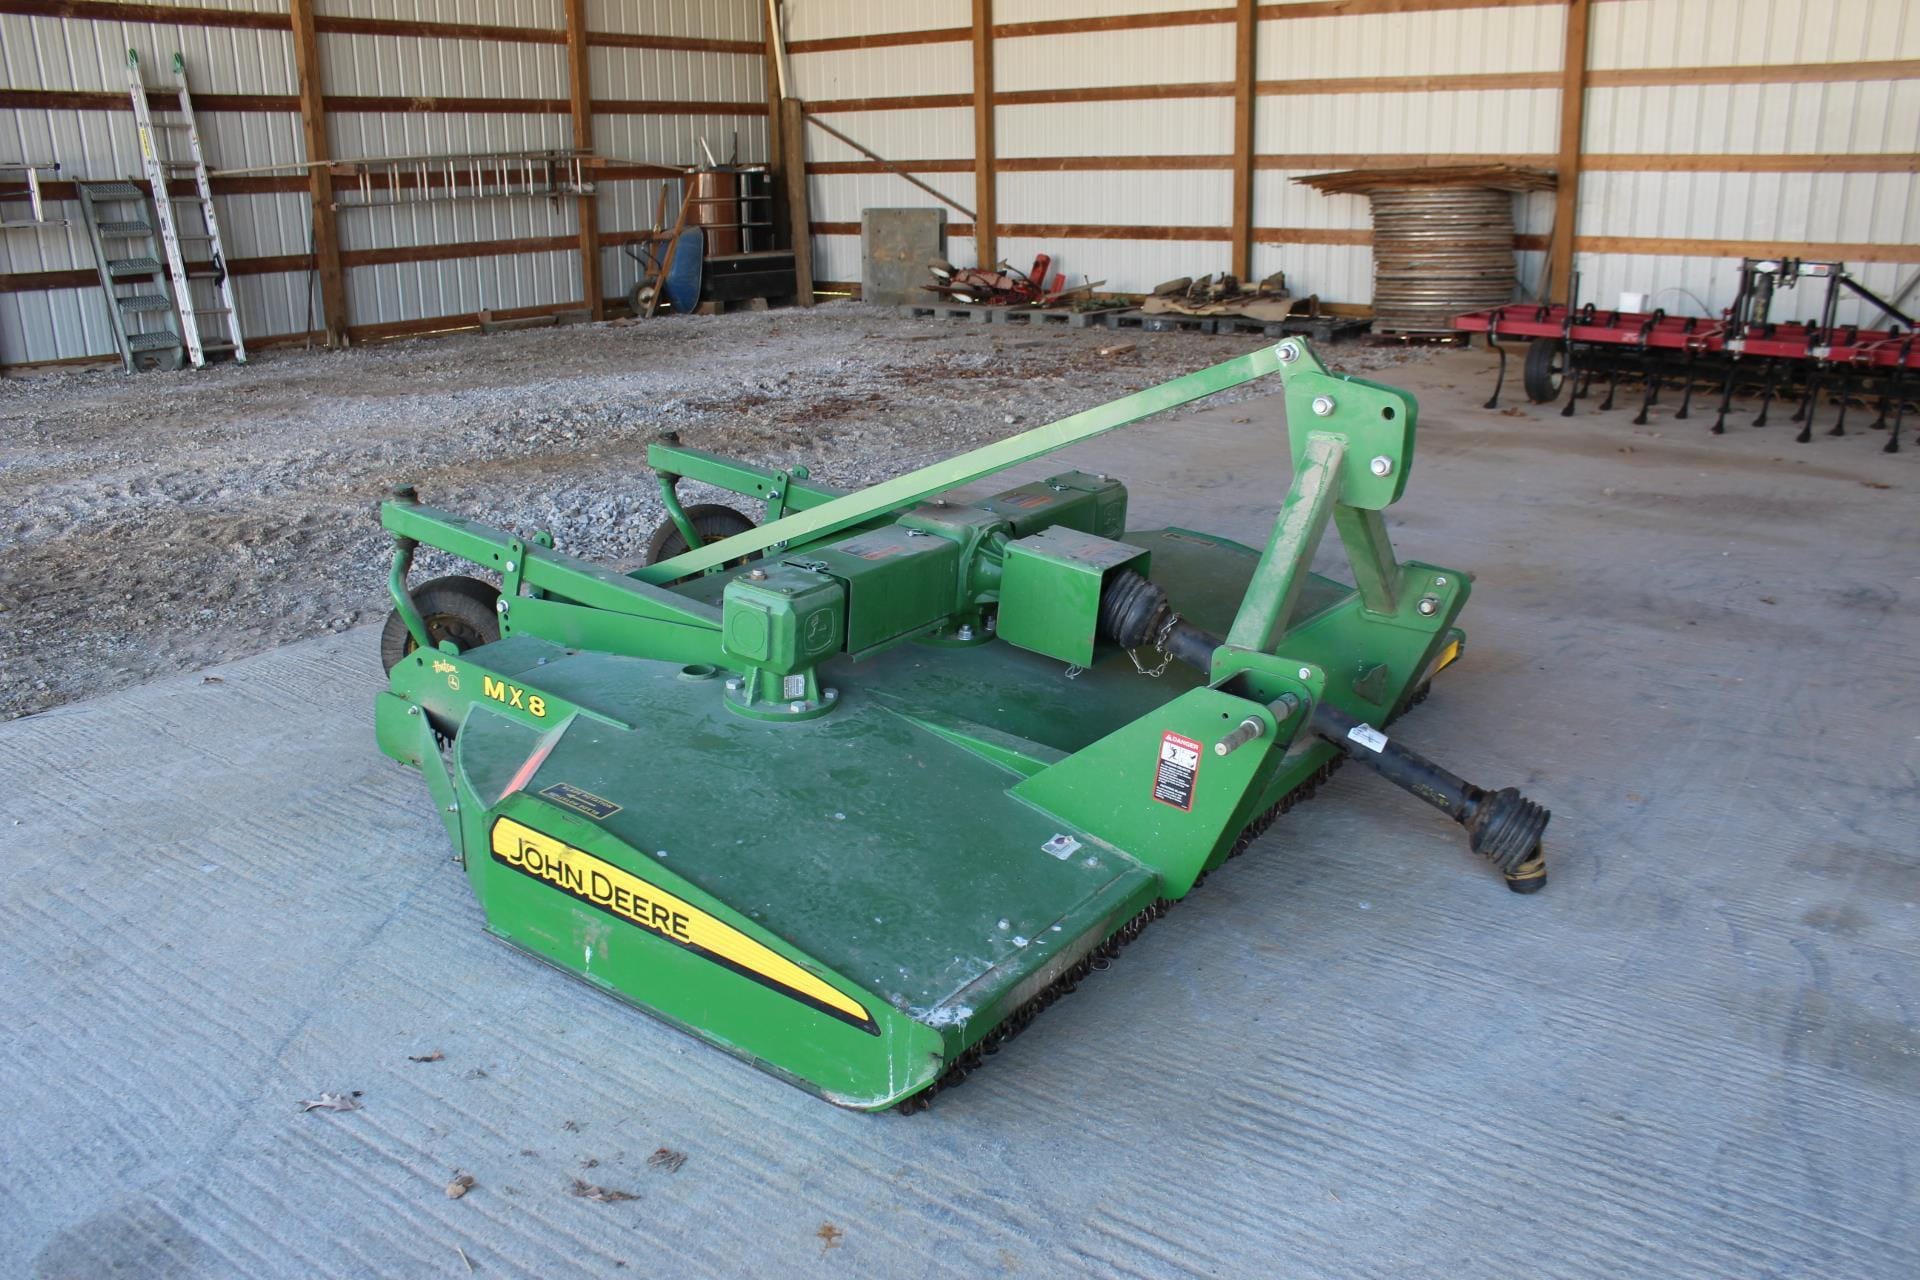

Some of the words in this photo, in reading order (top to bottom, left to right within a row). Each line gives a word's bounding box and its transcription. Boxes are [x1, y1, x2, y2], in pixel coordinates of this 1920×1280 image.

[484, 675, 546, 717] MX8
[1172, 736, 1199, 750] DANGER
[510, 837, 584, 891] JOHN
[590, 870, 691, 941] DEERE
